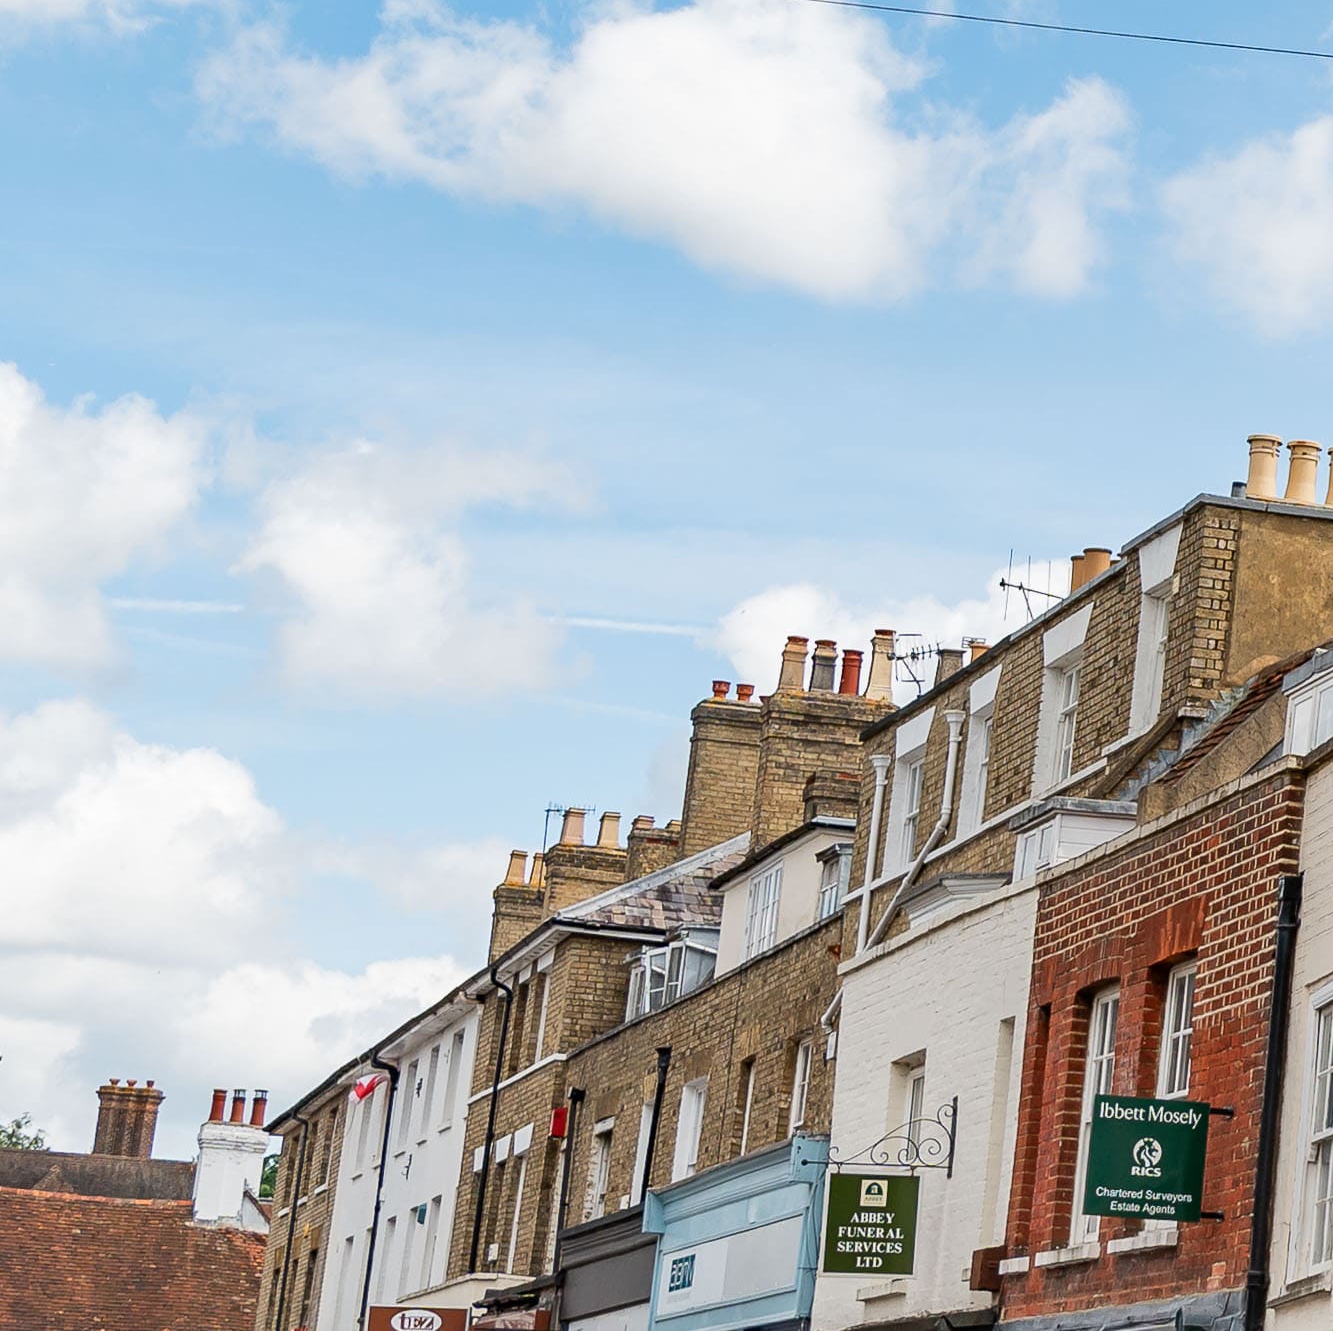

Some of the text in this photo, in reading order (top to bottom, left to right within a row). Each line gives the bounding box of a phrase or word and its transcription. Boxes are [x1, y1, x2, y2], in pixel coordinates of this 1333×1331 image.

[1100, 1101, 1202, 1129] Ibbett Mosely
[1131, 1166, 1162, 1177] RICS
[1095, 1186, 1193, 1203] Chartered Surveyors
[1110, 1200, 1176, 1215] Estate Agents
[850, 1212, 896, 1224] ABBEY
[837, 1226, 905, 1239] FUNERAL
[836, 1241, 904, 1254] SERVICES
[856, 1256, 883, 1268] LTD
